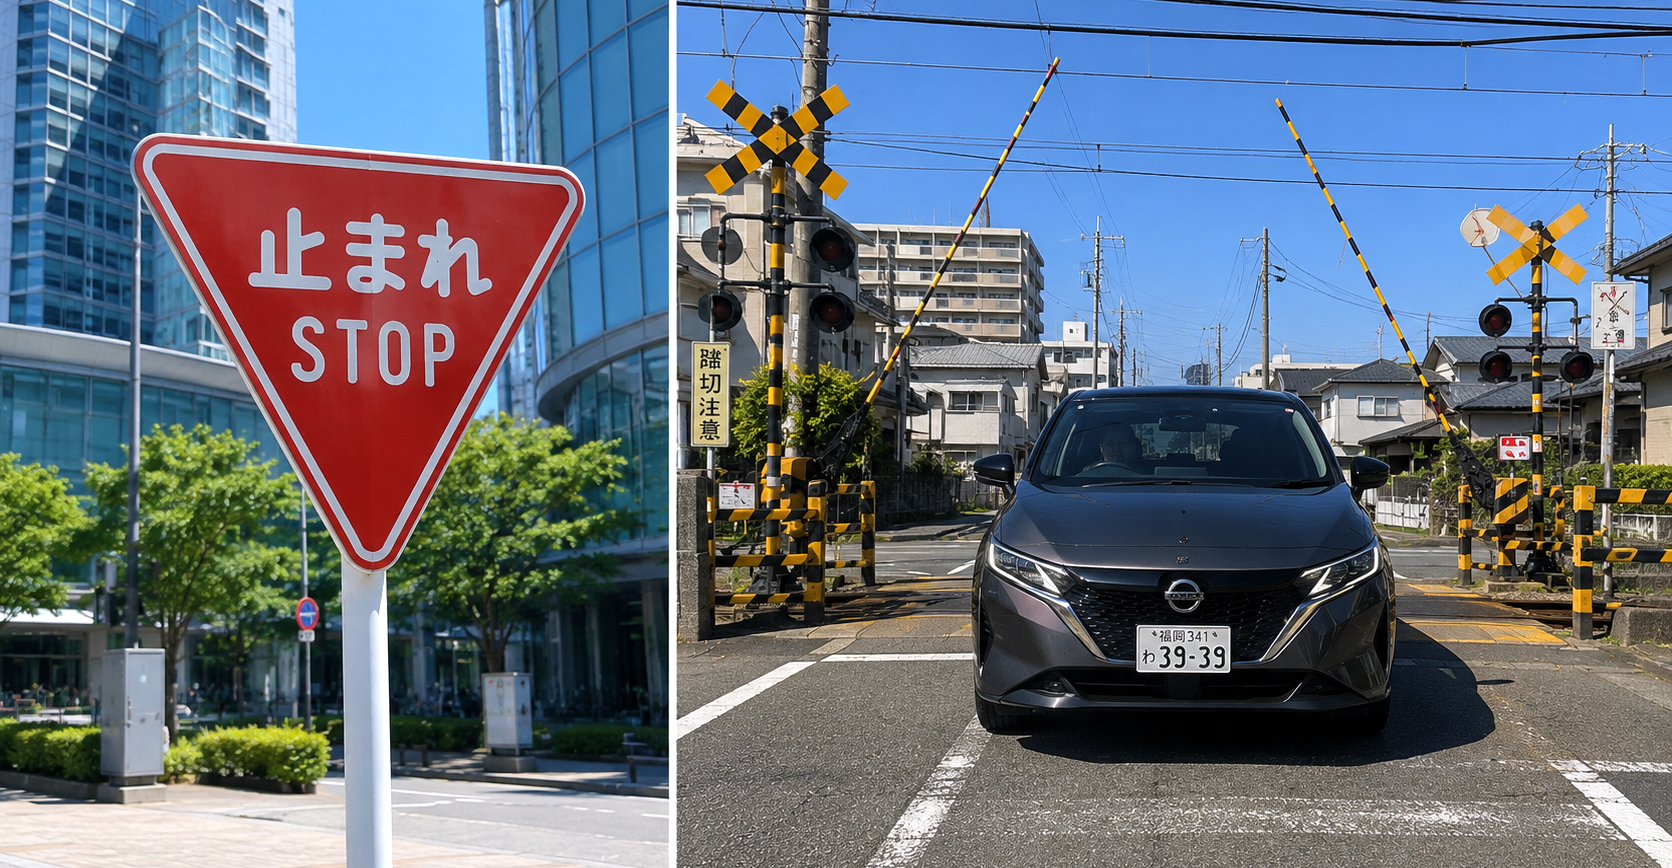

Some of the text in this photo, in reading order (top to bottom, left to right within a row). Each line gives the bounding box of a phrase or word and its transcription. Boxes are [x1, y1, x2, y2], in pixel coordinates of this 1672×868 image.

[248, 207, 493, 298] 止まれ
[291, 315, 456, 387] STOP
